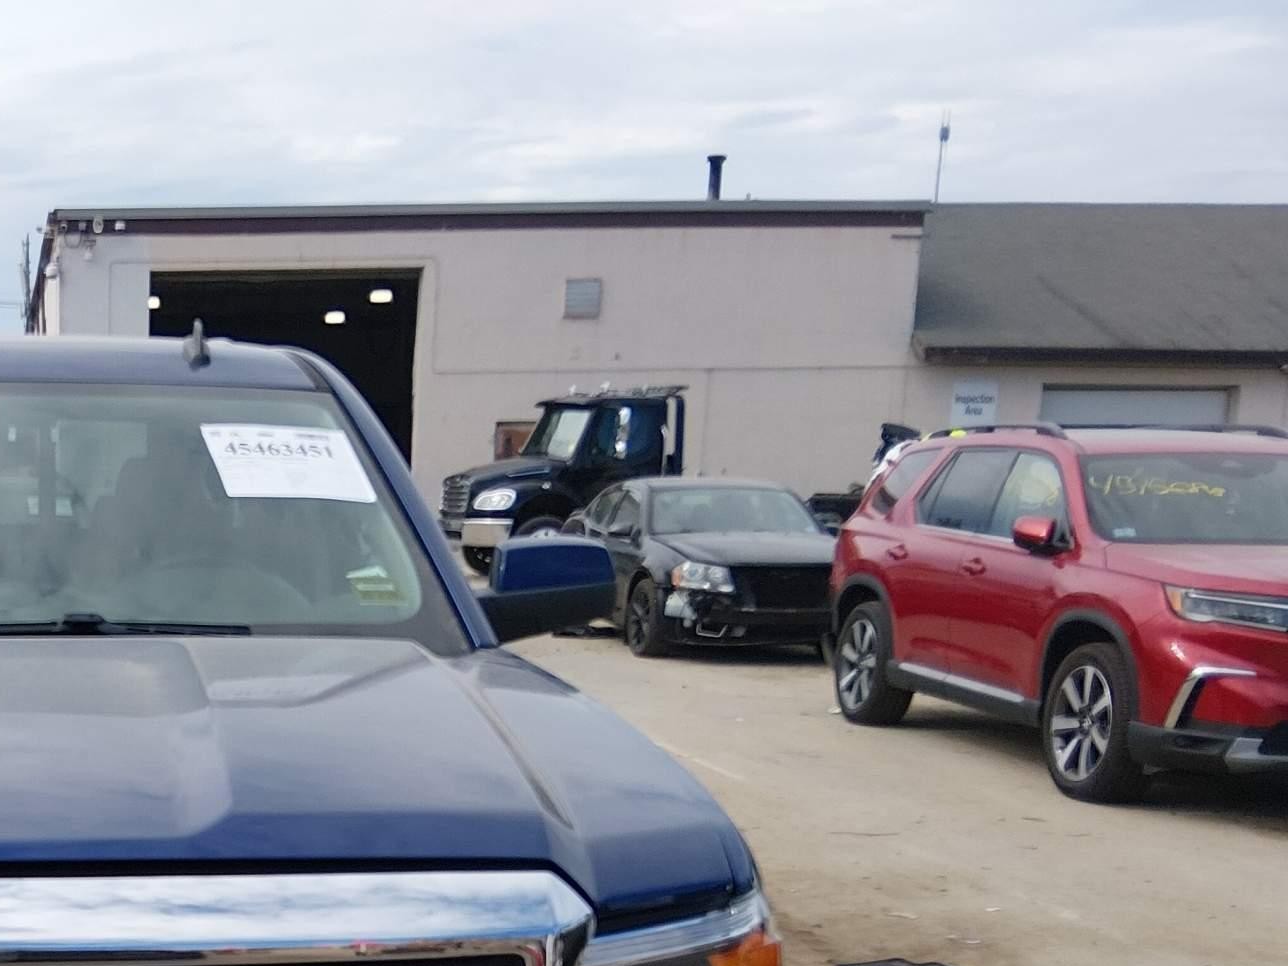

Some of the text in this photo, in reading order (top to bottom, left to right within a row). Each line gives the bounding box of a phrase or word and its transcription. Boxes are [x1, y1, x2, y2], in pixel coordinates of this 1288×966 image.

[954, 394, 995, 405] Inspection
[964, 405, 984, 416] Area
[224, 442, 334, 459] 45463451
